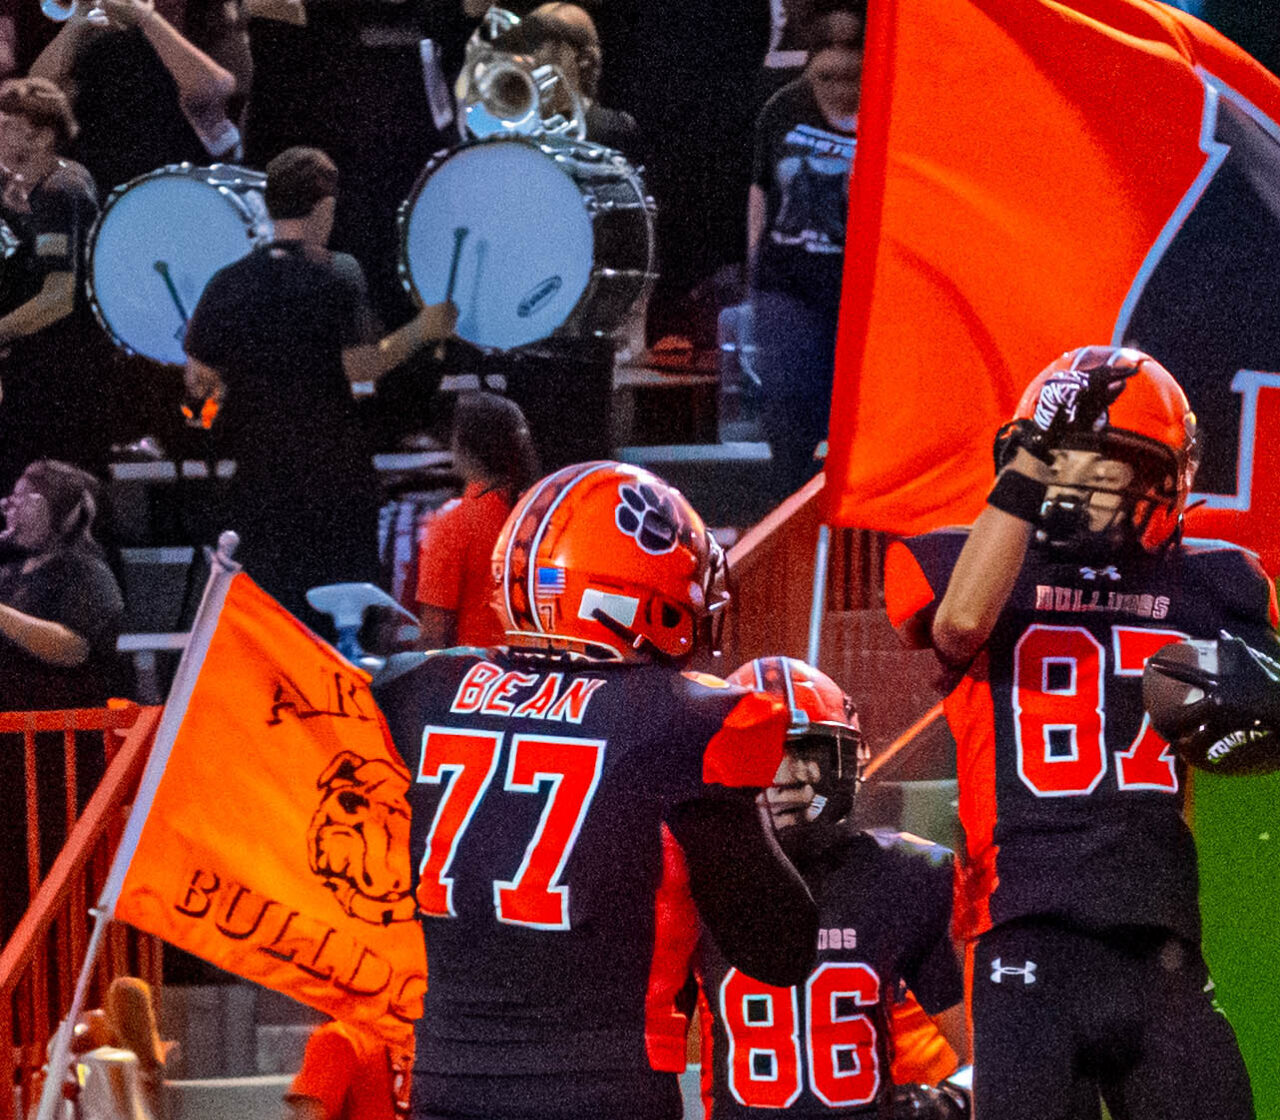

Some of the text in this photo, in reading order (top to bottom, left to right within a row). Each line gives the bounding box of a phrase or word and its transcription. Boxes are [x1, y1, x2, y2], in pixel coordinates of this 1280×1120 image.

[450, 661, 608, 725] BEAN
[1012, 623, 1190, 798] 87
[416, 725, 608, 931] 77
[719, 962, 881, 1109] 86
